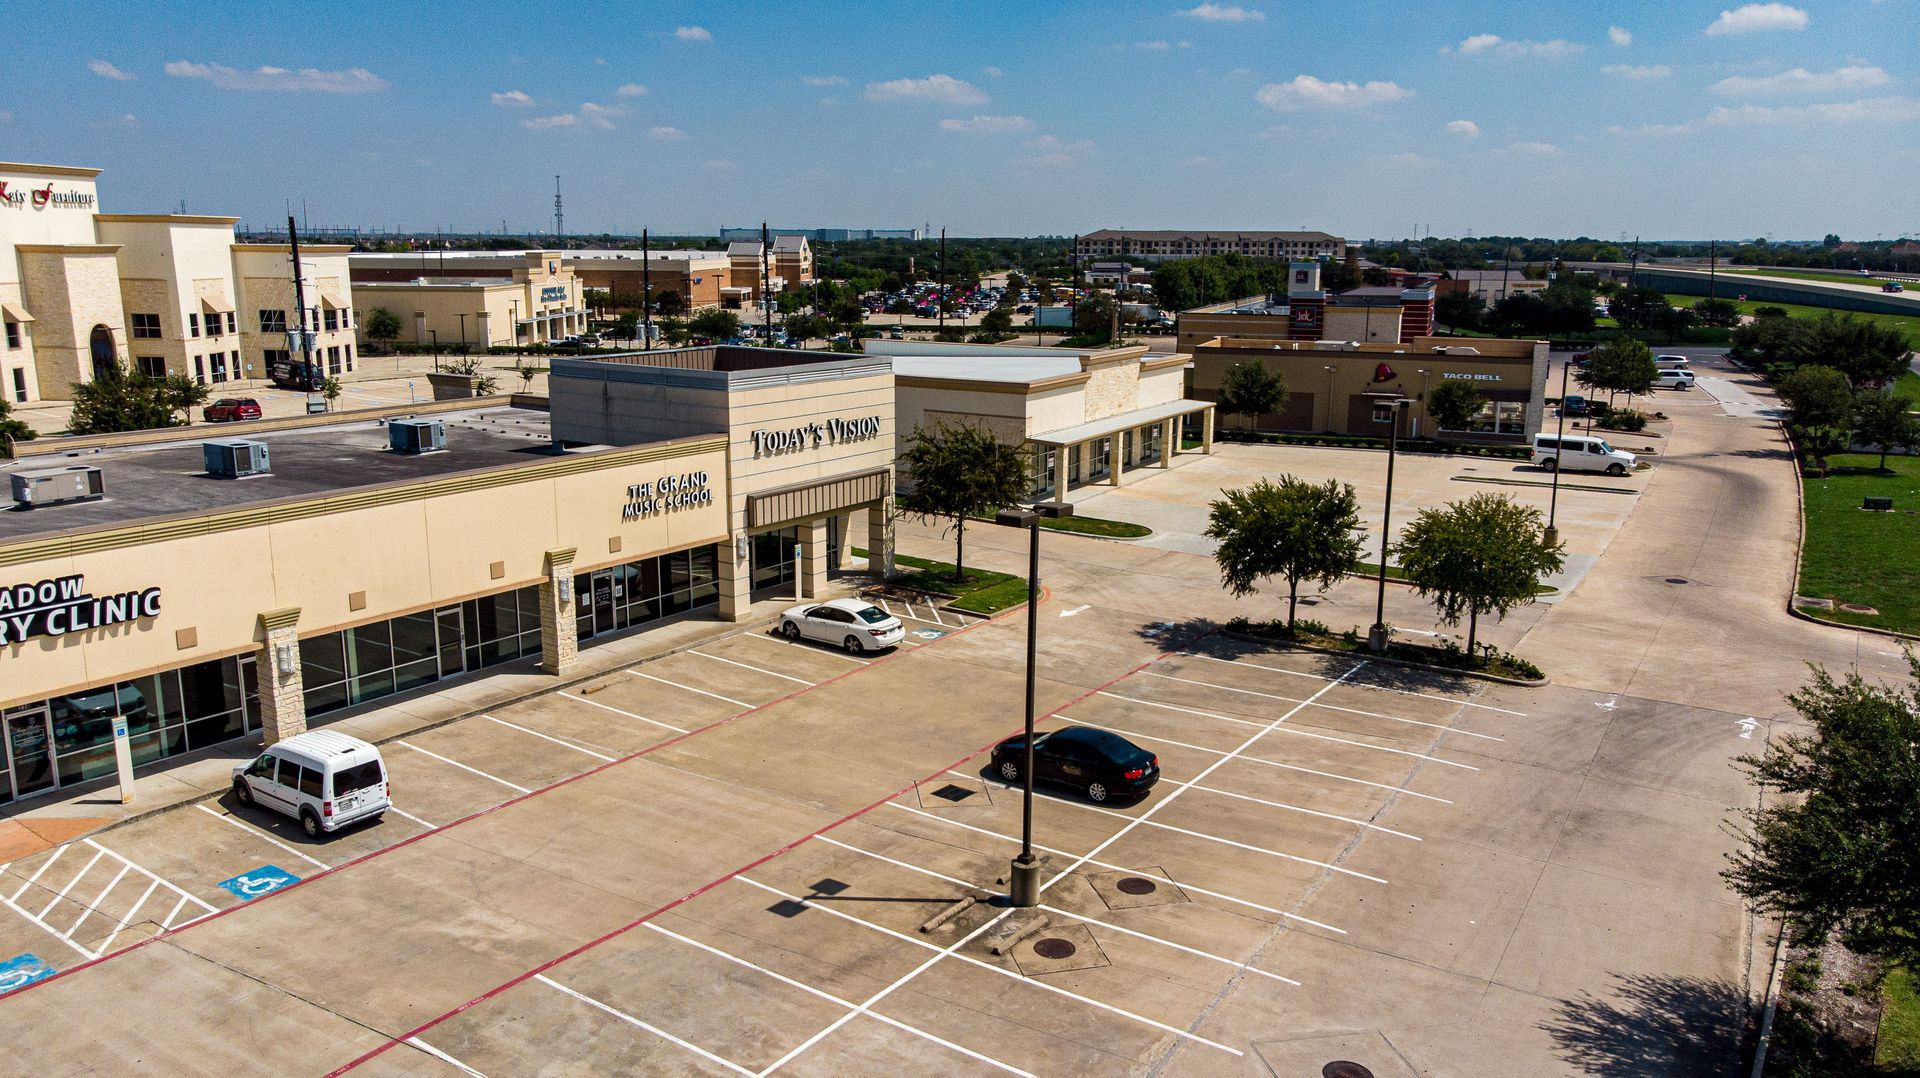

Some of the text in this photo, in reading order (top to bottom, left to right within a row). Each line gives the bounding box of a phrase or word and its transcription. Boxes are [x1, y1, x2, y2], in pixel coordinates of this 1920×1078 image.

[31, 182, 95, 205] Furniture
[828, 415, 880, 440] VISION
[629, 471, 709, 498] THE GRAND
[623, 489, 714, 517] MUSIC SCHOOL
[46, 588, 161, 636] CLINIC
